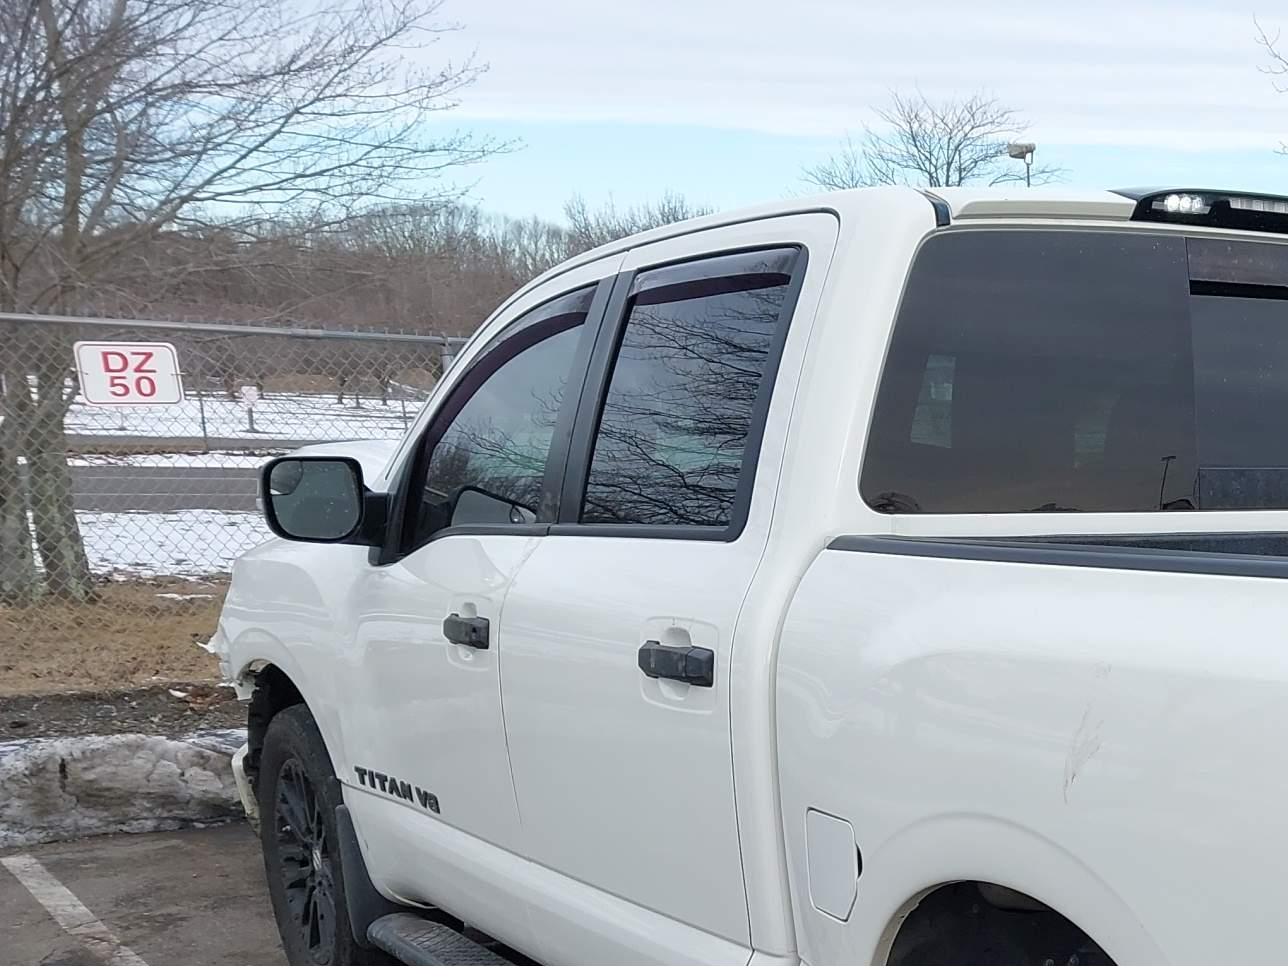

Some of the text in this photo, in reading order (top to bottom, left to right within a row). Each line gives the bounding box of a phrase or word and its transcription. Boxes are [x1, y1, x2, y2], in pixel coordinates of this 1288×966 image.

[101, 351, 157, 373] DZ
[109, 376, 157, 397] 50
[354, 765, 414, 803] TITAN
